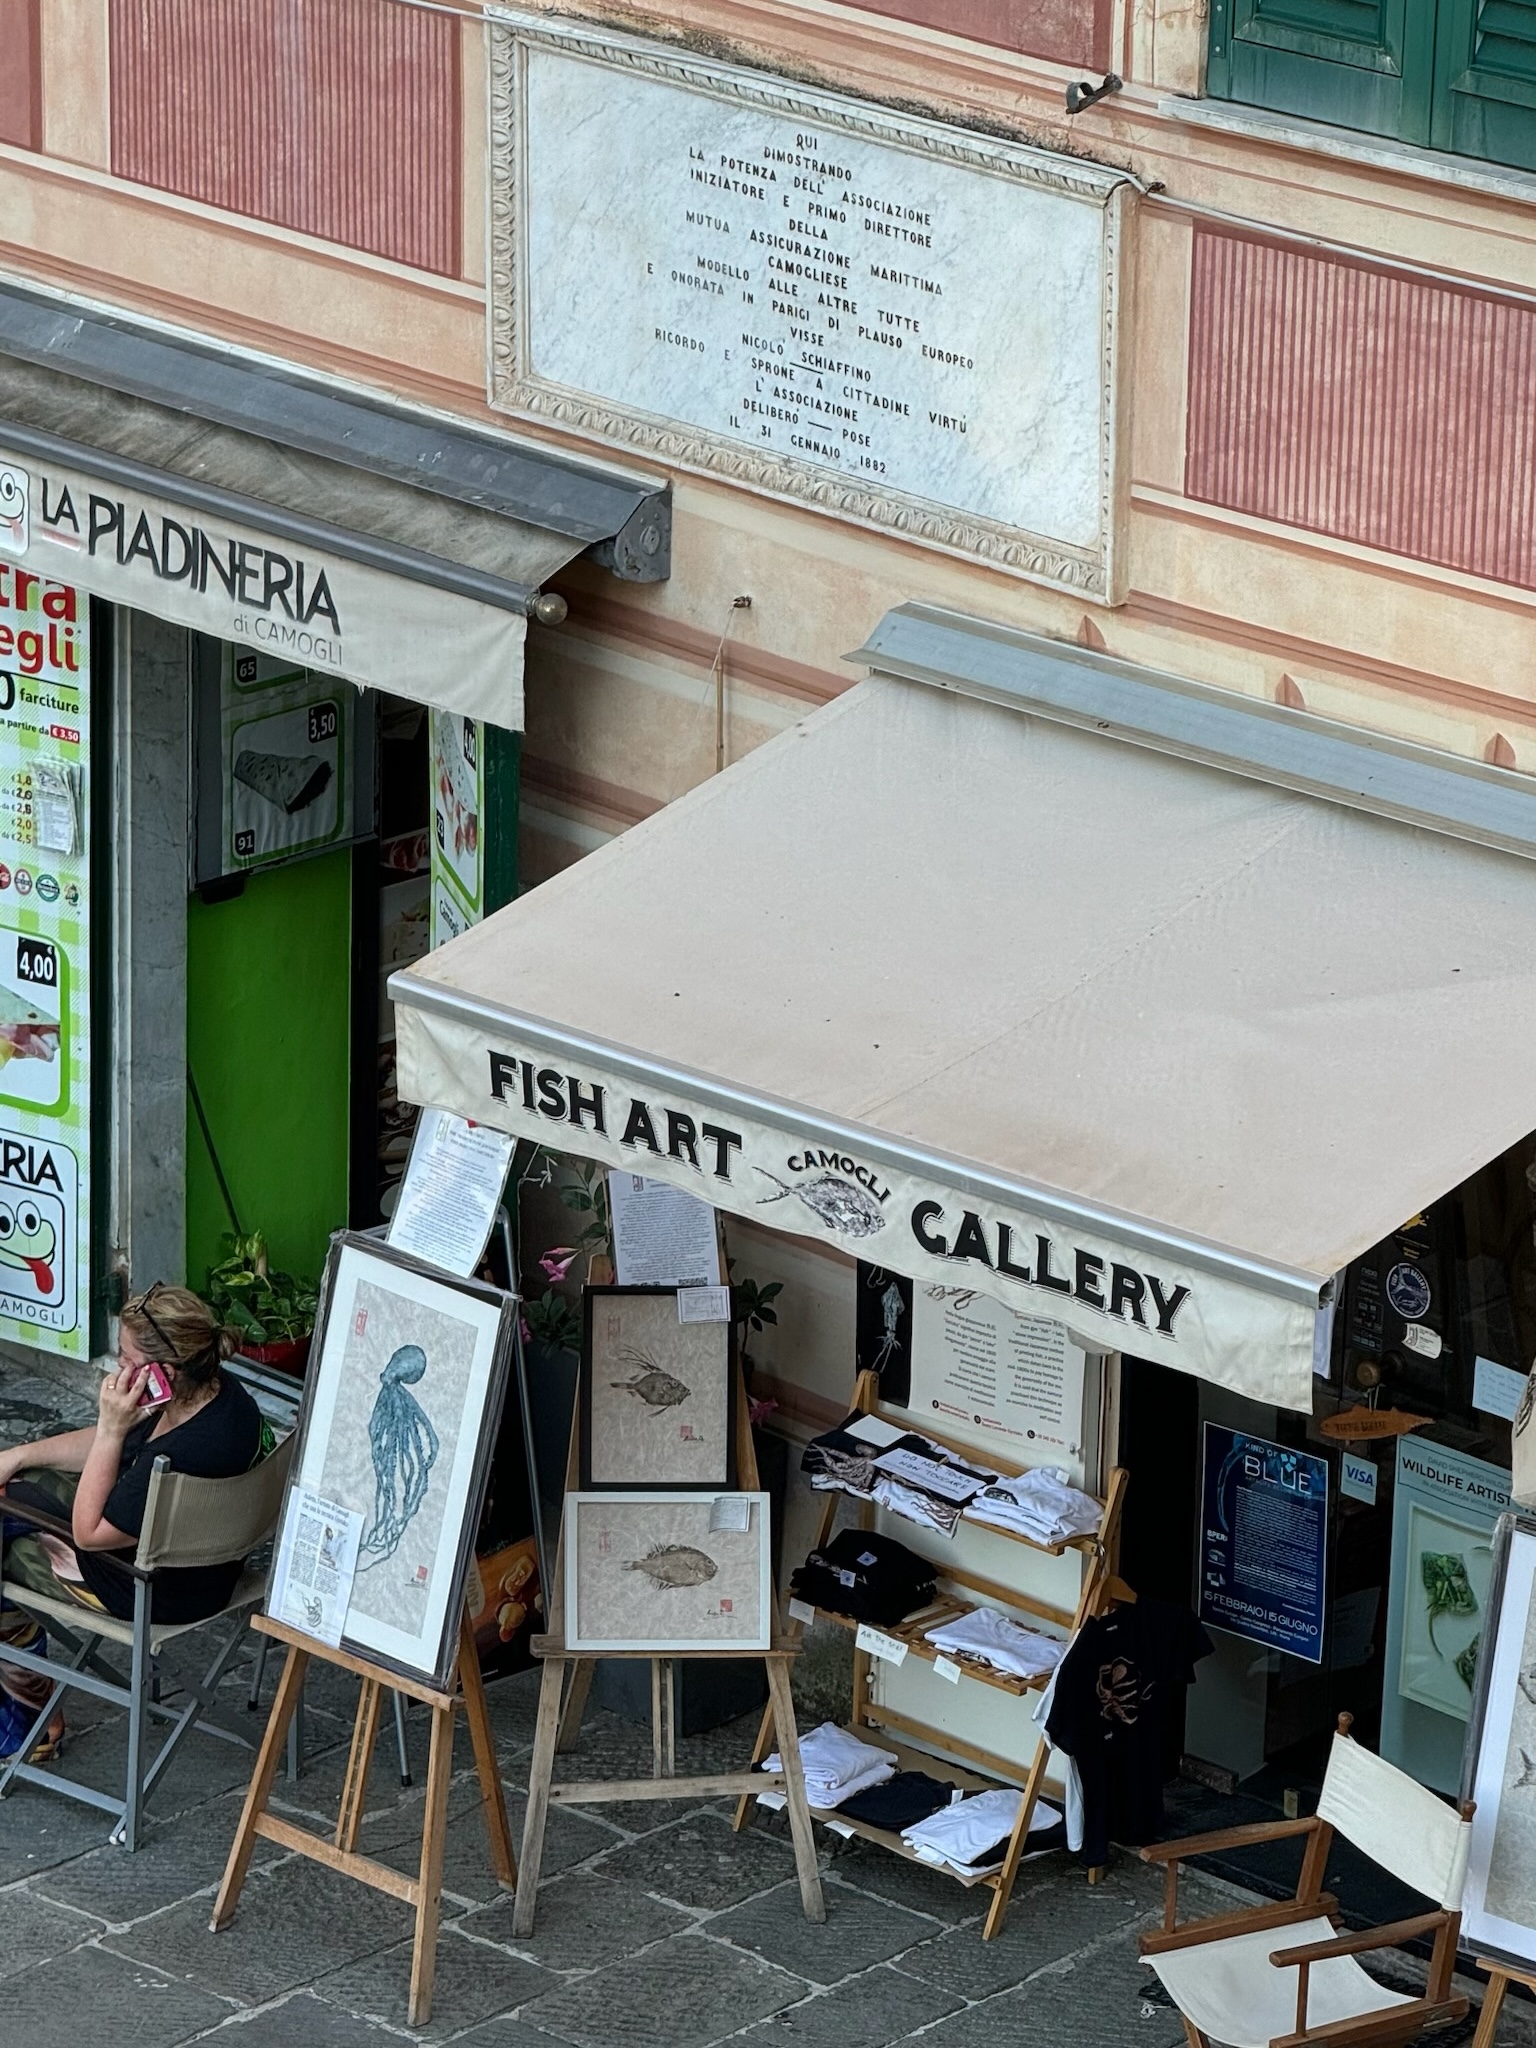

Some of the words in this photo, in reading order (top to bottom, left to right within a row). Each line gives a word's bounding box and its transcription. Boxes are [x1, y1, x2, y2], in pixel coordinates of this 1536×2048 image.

[796, 134, 818, 150] QUI
[763, 147, 852, 181] DIMOSTRANDO
[689, 147, 705, 162] LA
[721, 155, 777, 182] POTENZA
[793, 176, 826, 195] DELL'
[842, 191, 932, 226] ASSOCIAZIONE
[690, 168, 765, 200] INIZIATORE
[783, 195, 790, 208] E
[808, 202, 847, 223] PRIMO
[864, 218, 932, 248] DIRETTORE
[788, 218, 828, 240] DELLA
[685, 210, 730, 233] MUTUA
[749, 229, 851, 269] ASSICURAZIONE
[870, 264, 943, 296] MARITTIMA
[768, 256, 848, 290] CAMOGLIESE
[696, 256, 750, 281] MODELLO
[768, 278, 798, 297] ALLE
[817, 292, 858, 315] ALTRE
[877, 309, 920, 333] TUTTE
[647, 262, 654, 275] E
[671, 270, 724, 296] ONORATA
[742, 291, 754, 305] IN
[772, 300, 810, 322] PARIGI
[828, 316, 840, 331] DI
[858, 326, 903, 349] PLAUSO
[921, 344, 974, 370] EUROPEO
[790, 326, 825, 347] VISSE
[654, 327, 706, 353] RICORDO
[724, 349, 731, 362] E
[751, 357, 795, 381] SPRONE
[816, 377, 824, 391] A
[843, 385, 910, 416] CITTADINE
[801, 351, 872, 383] SCHIAFFINO
[729, 415, 741, 429] IL
[761, 425, 772, 438] 31
[790, 435, 841, 459] GENNAIO
[859, 455, 886, 474] 1882
[842, 428, 872, 448] POSE
[41, 477, 80, 533] LA
[88, 493, 342, 636] PIADINERIA
[233, 613, 250, 634] di
[254, 617, 343, 666] CAMOGLI
[239, 660, 256, 677] 65
[20, 688, 80, 714] farciture
[7, 719, 37, 733] partire
[39, 726, 49, 735] da
[60, 729, 79, 742] 3,50
[310, 712, 336, 740] 3,50
[238, 833, 254, 851] 91
[19, 951, 53, 981] 4,00
[487, 1049, 607, 1136] FISH
[620, 1097, 743, 1183] ART
[787, 1149, 892, 1203] CAMOGLI
[911, 1200, 1192, 1337] GALLERY
[1245, 1455, 1311, 1495] BLUE
[1345, 1464, 1375, 1487] VISA
[1402, 1457, 1463, 1490] WILDLIFE
[1466, 1482, 1511, 1507] ARTIST
[1214, 1593, 1263, 1618] FEBBRAIO
[1278, 1615, 1318, 1636] GIUGNO
